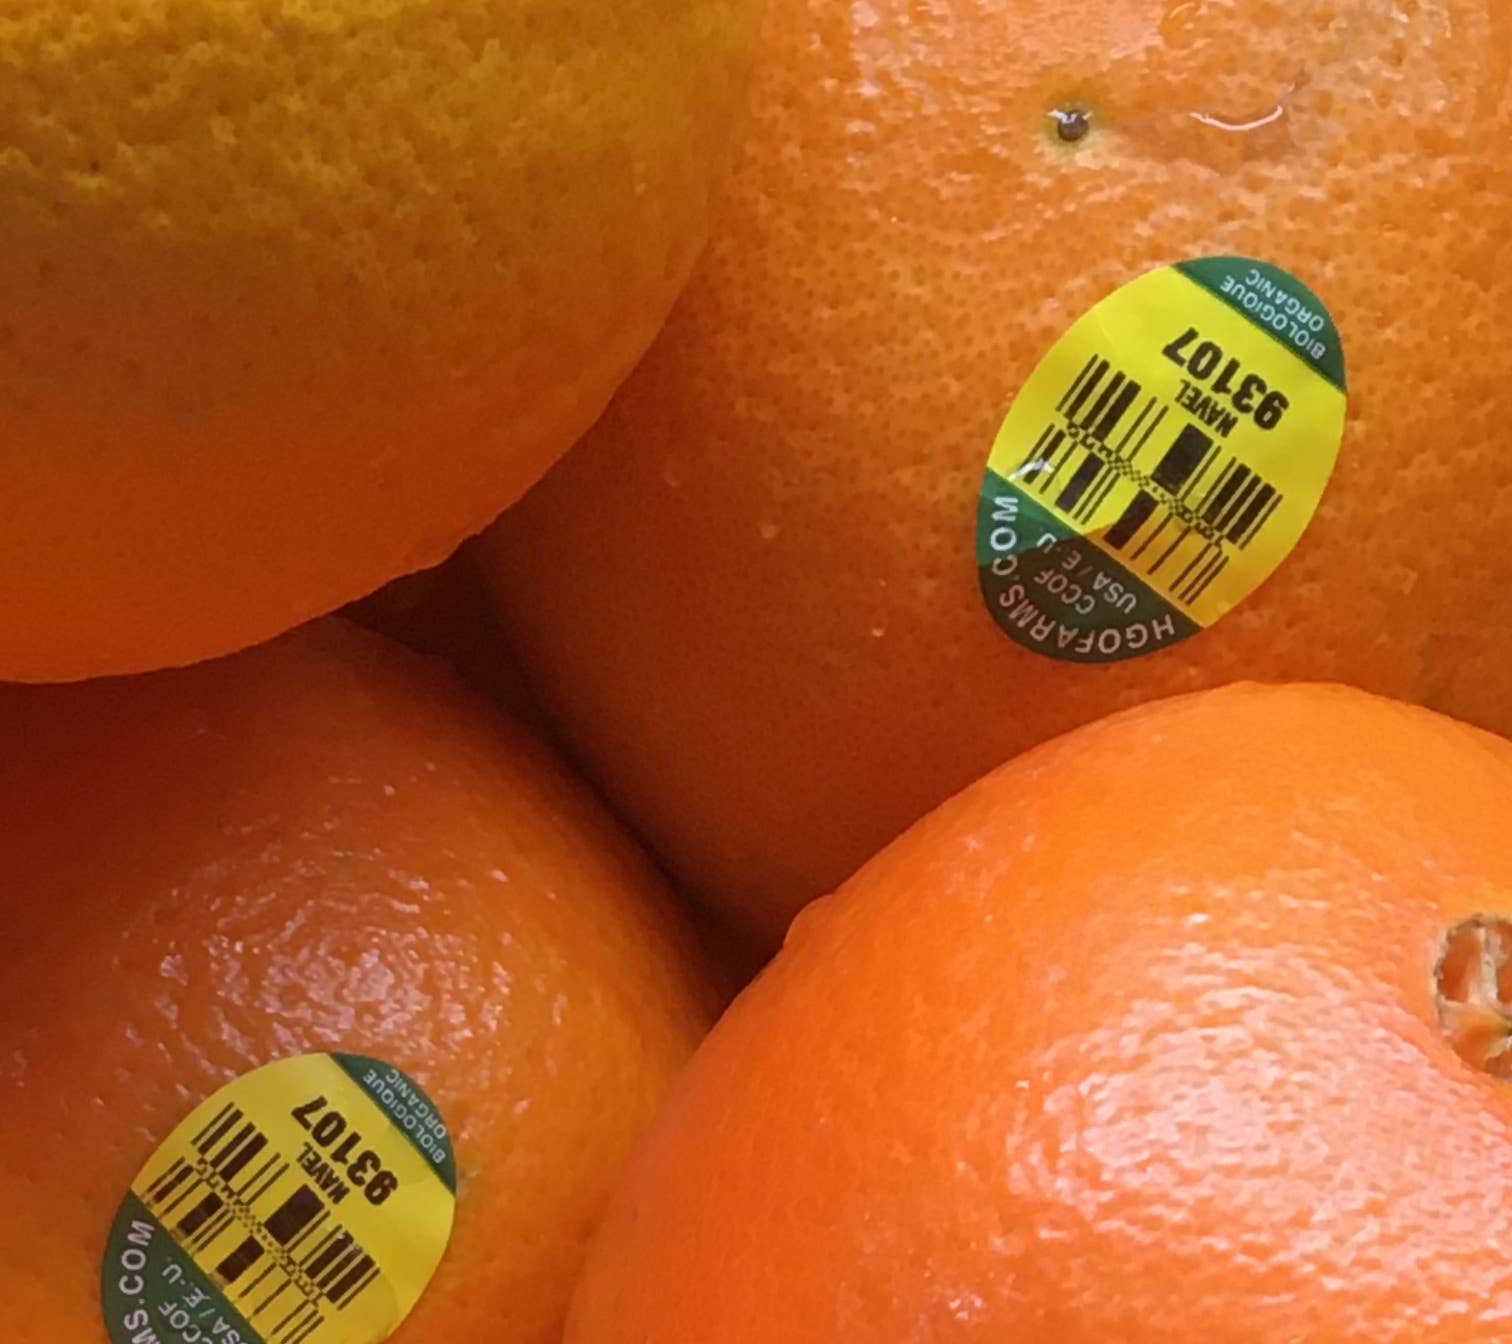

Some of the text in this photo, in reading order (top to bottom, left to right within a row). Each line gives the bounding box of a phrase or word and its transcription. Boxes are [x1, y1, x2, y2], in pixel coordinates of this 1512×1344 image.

[1220, 274, 1326, 359] BIOLOGIQUE
[1245, 268, 1324, 332] ORGANIC
[1162, 326, 1289, 430] 93107
[1174, 379, 1238, 438] NAVEL
[990, 495, 1175, 654] HGOFARMS.COM
[1034, 569, 1096, 614] CCOF
[1093, 571, 1137, 614] USA
[363, 1068, 447, 1164] BIOLOGIQUE
[385, 1068, 447, 1139] ORGANIC
[291, 1095, 398, 1205] 93107
[297, 1142, 350, 1205] NAVEL
